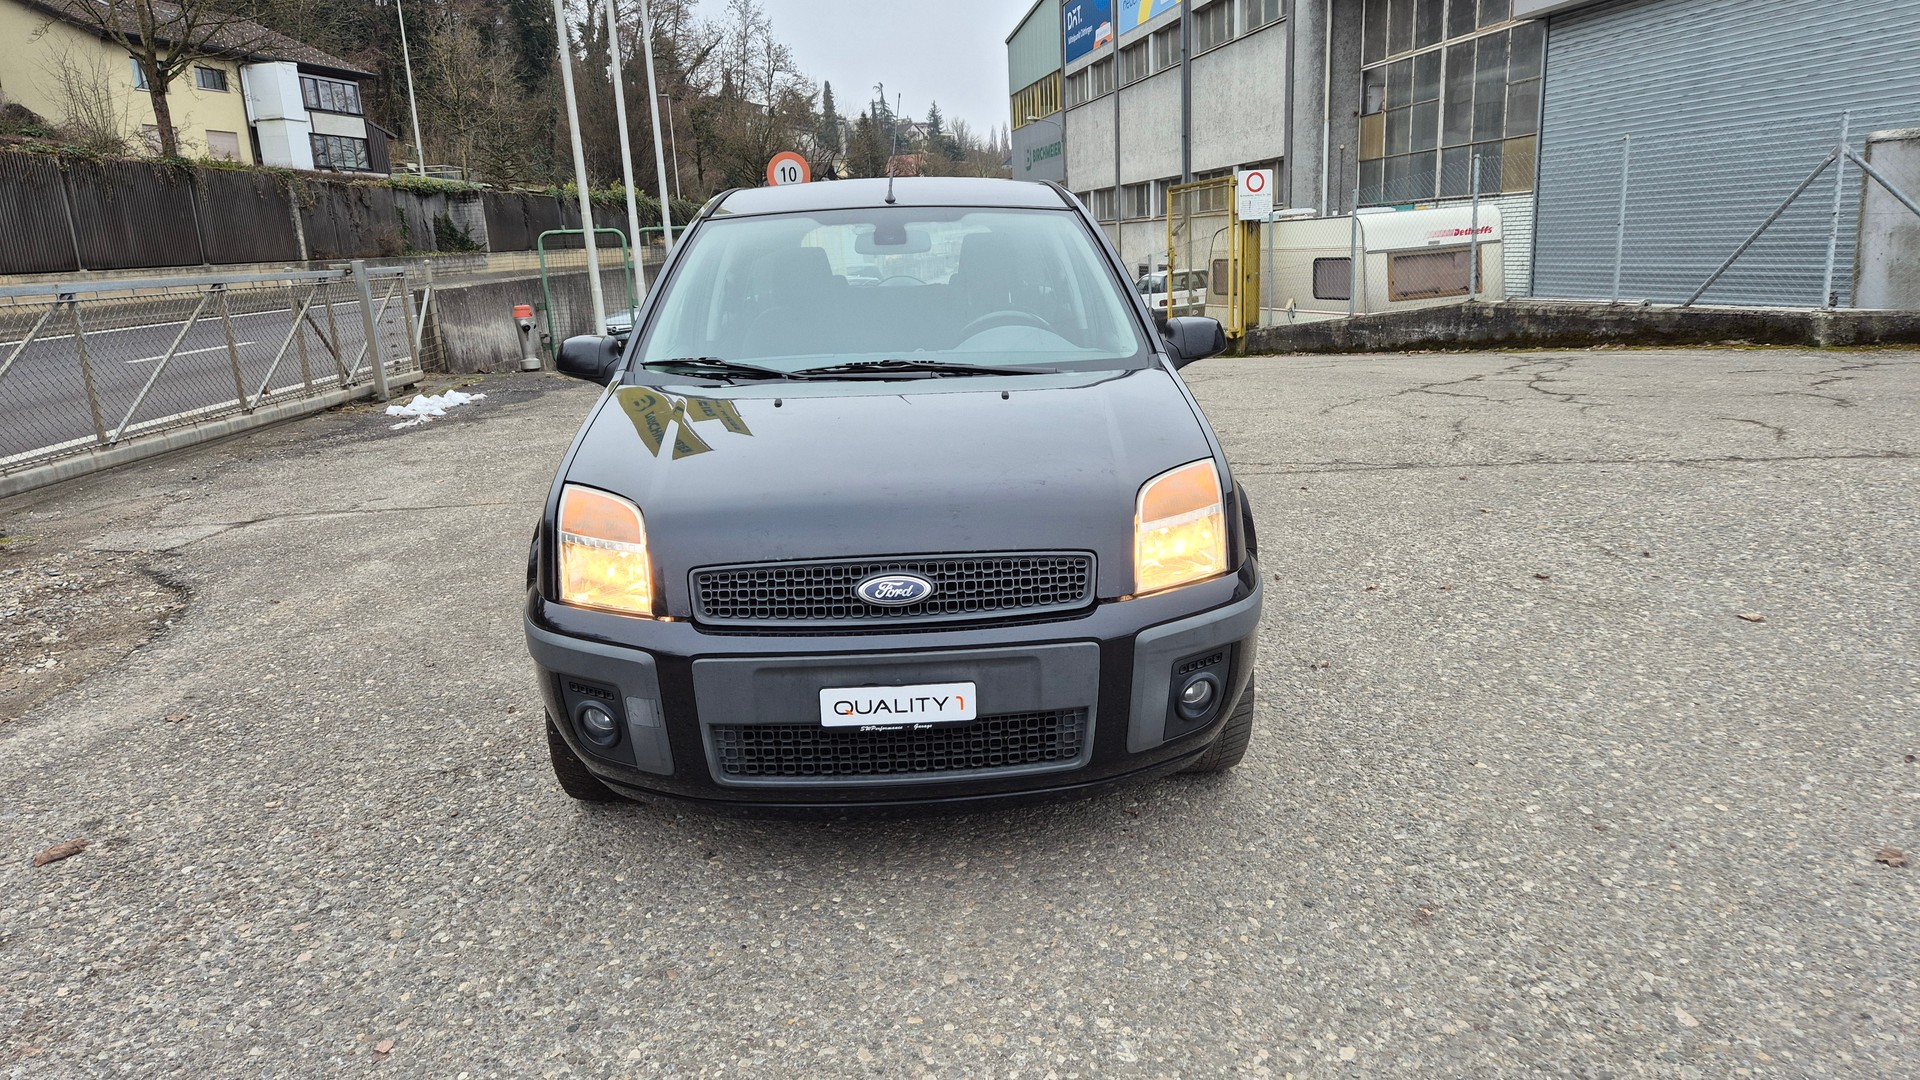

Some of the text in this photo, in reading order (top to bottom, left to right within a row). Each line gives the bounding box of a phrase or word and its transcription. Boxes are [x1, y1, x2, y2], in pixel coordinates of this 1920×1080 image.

[780, 166, 797, 183] 10
[1453, 225, 1493, 237] Detheffs
[874, 581, 914, 599] Ford
[833, 695, 965, 716] QUALITY 1
[913, 723, 933, 731] Garage
